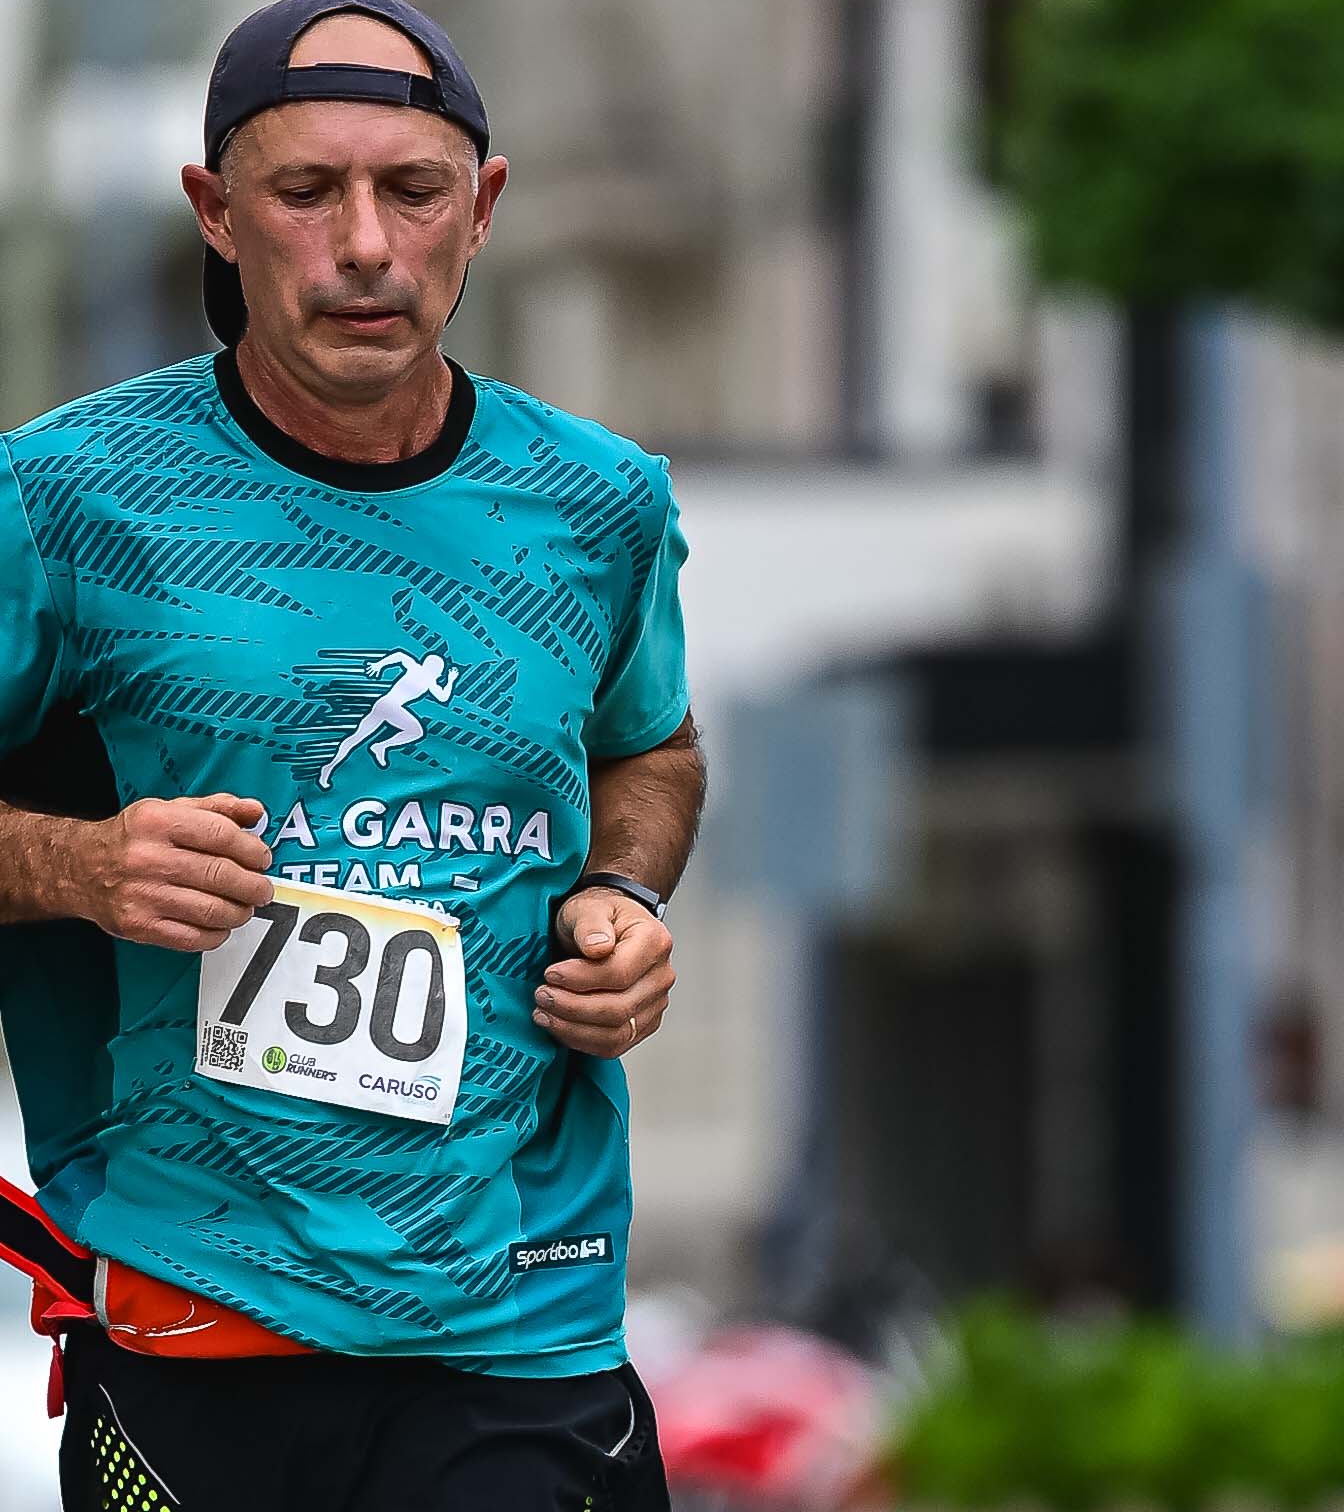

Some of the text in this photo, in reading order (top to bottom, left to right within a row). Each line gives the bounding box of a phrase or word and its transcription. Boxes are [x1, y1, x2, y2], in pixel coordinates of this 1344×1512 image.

[342, 800, 552, 860] GARRA
[282, 863, 421, 892] TEAM
[218, 900, 446, 1062] 730
[290, 1054, 316, 1066] CLUB
[359, 1074, 437, 1101] CARUSO
